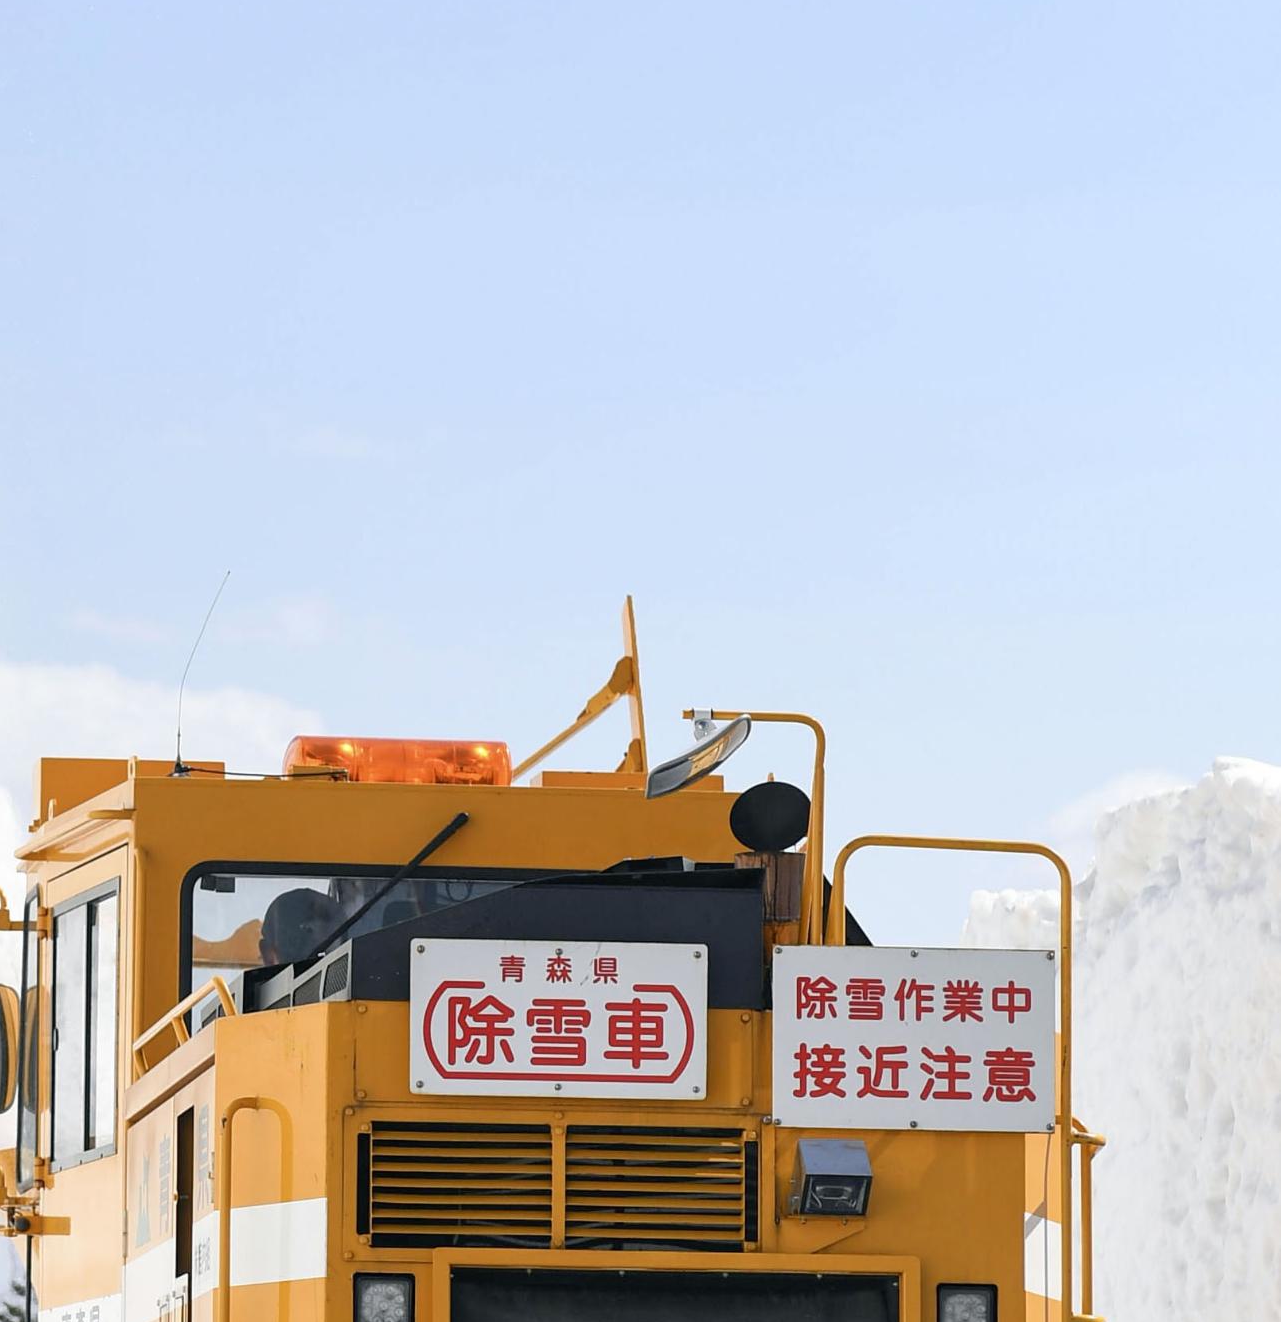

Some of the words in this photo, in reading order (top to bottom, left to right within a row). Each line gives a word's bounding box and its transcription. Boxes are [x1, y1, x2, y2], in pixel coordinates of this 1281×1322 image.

[498, 955, 619, 985] 青森県
[795, 975, 1033, 1025] 除雪作業中
[447, 994, 669, 1069] 除雪車
[793, 1041, 1037, 1103] 接近注意
